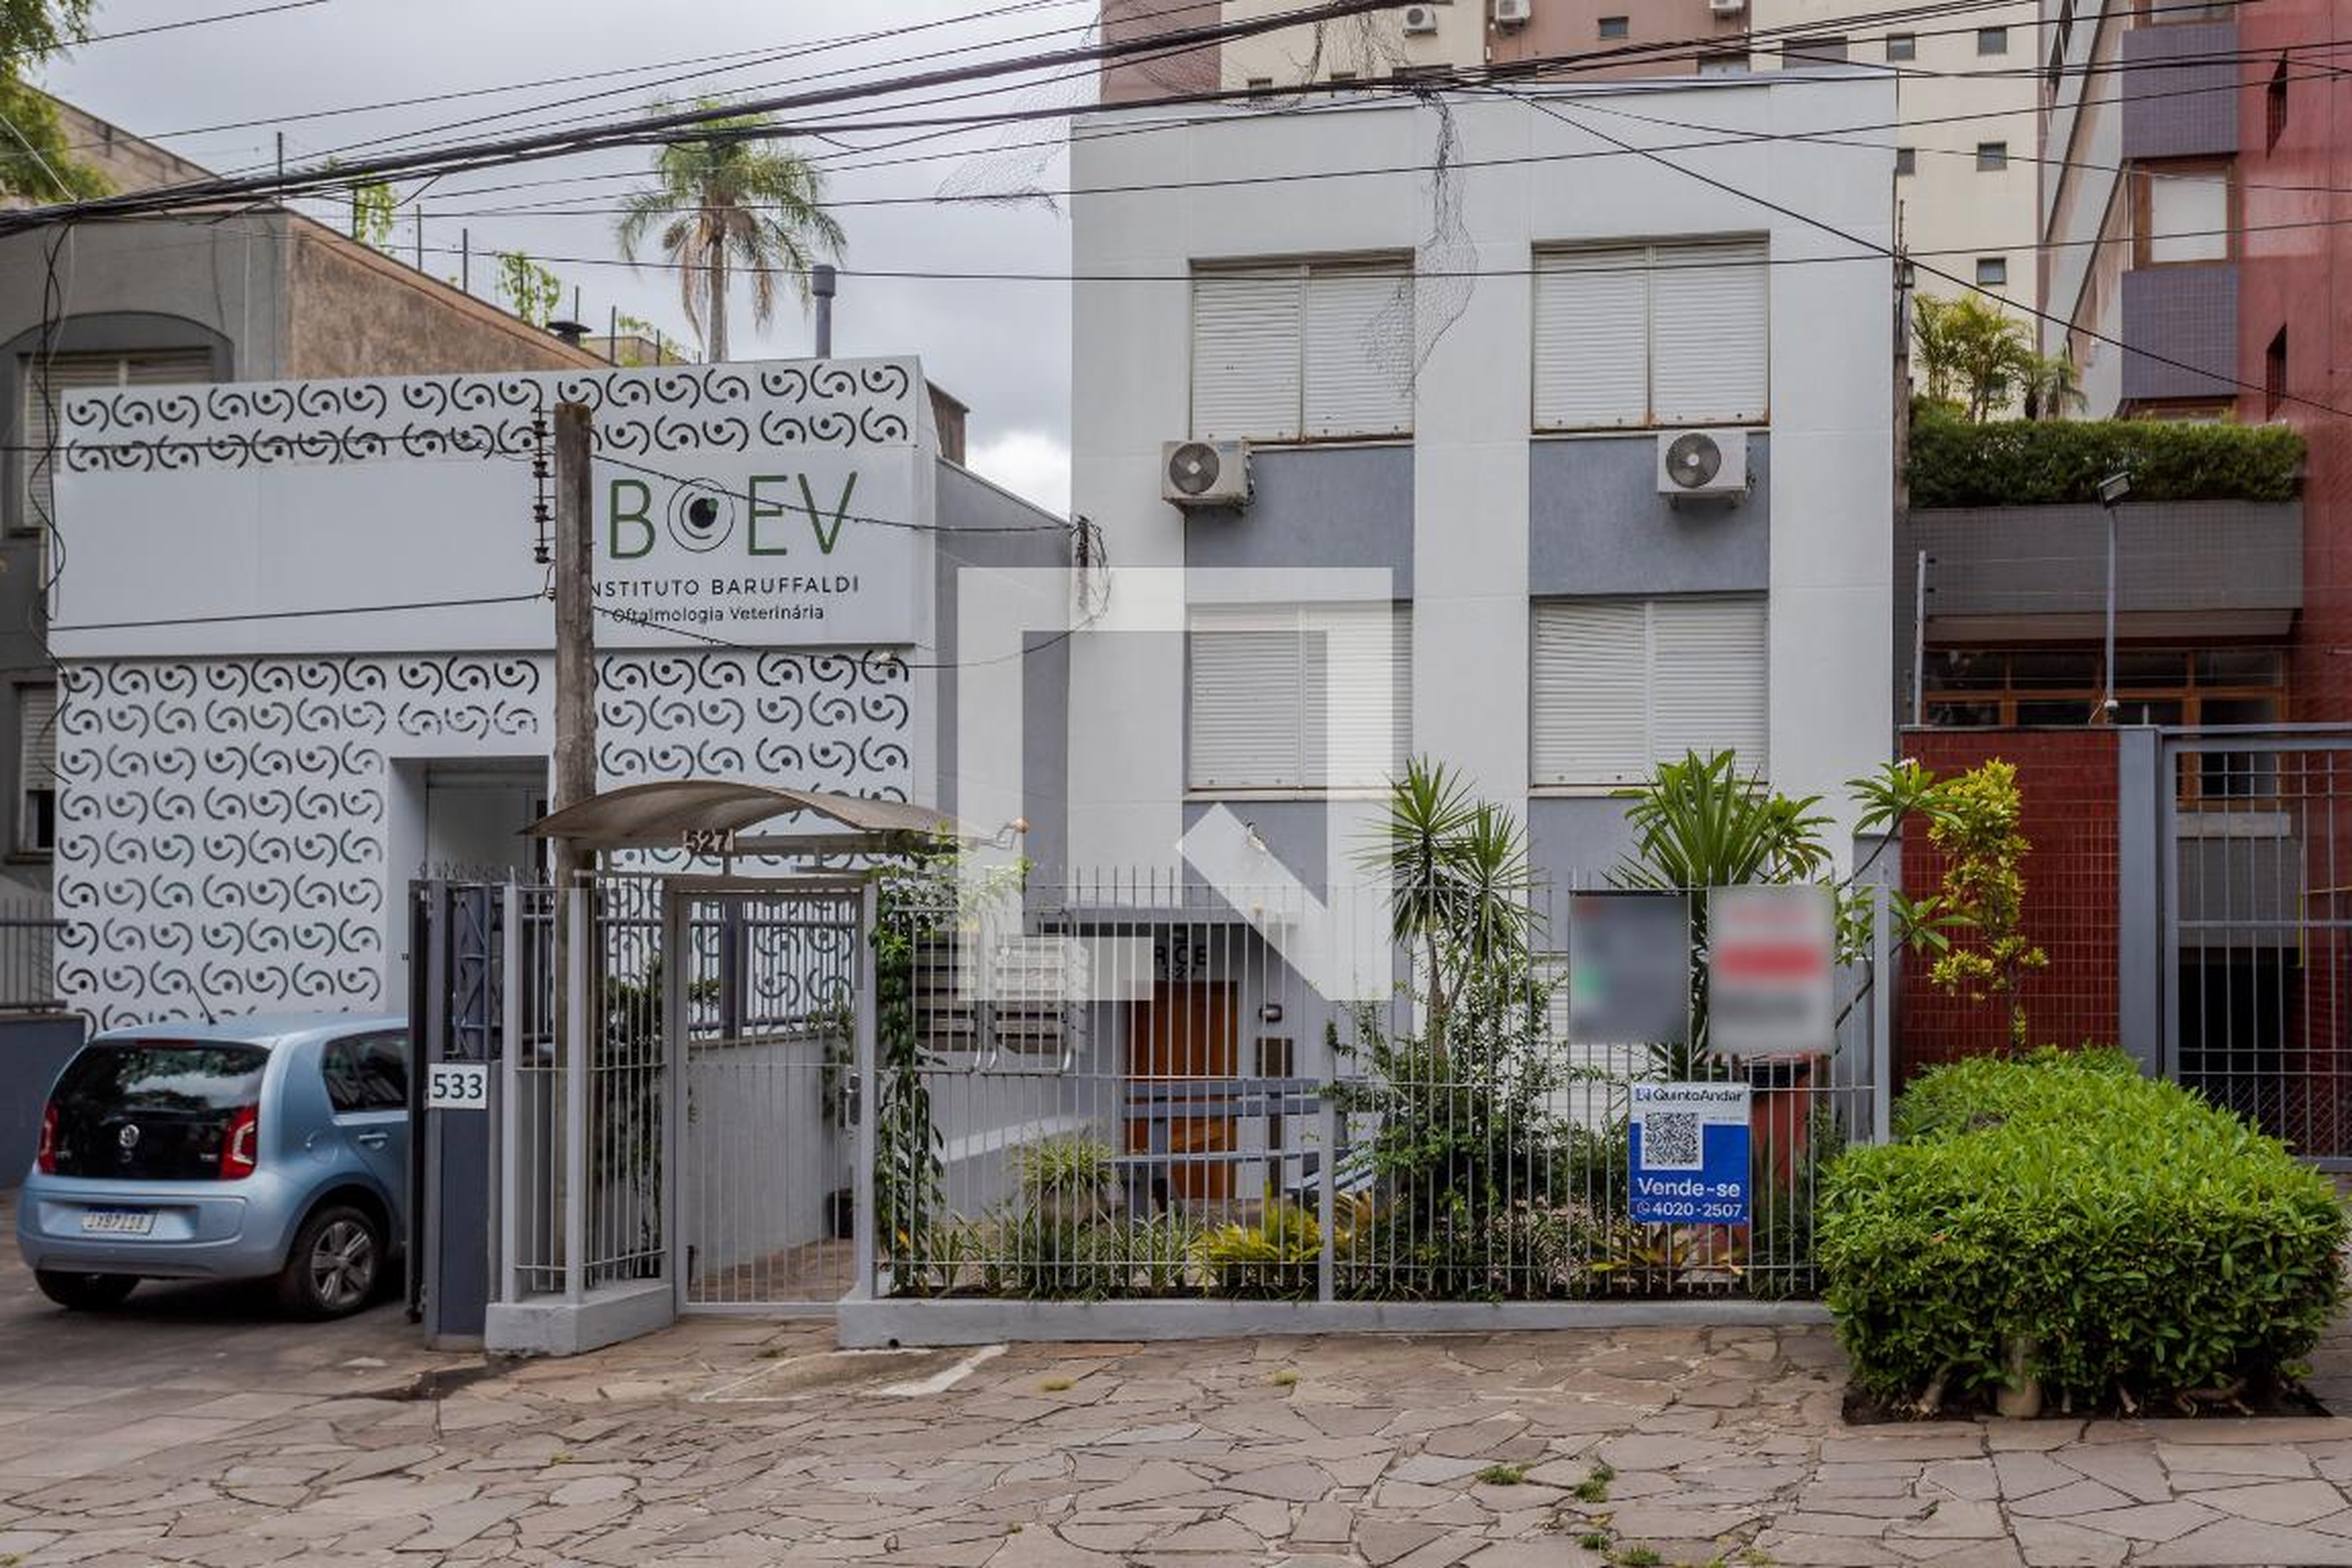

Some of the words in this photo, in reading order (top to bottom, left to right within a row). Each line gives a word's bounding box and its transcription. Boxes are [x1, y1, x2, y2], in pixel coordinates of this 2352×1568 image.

[591, 578, 699, 597] NSTITUTO
[711, 575, 858, 595] BARUFFALDI
[730, 603, 824, 620] Veterinária
[432, 1073, 483, 1099] 533
[1653, 1088, 1742, 1102] QuintoAndar
[1637, 1177, 1741, 1197] Vende-se
